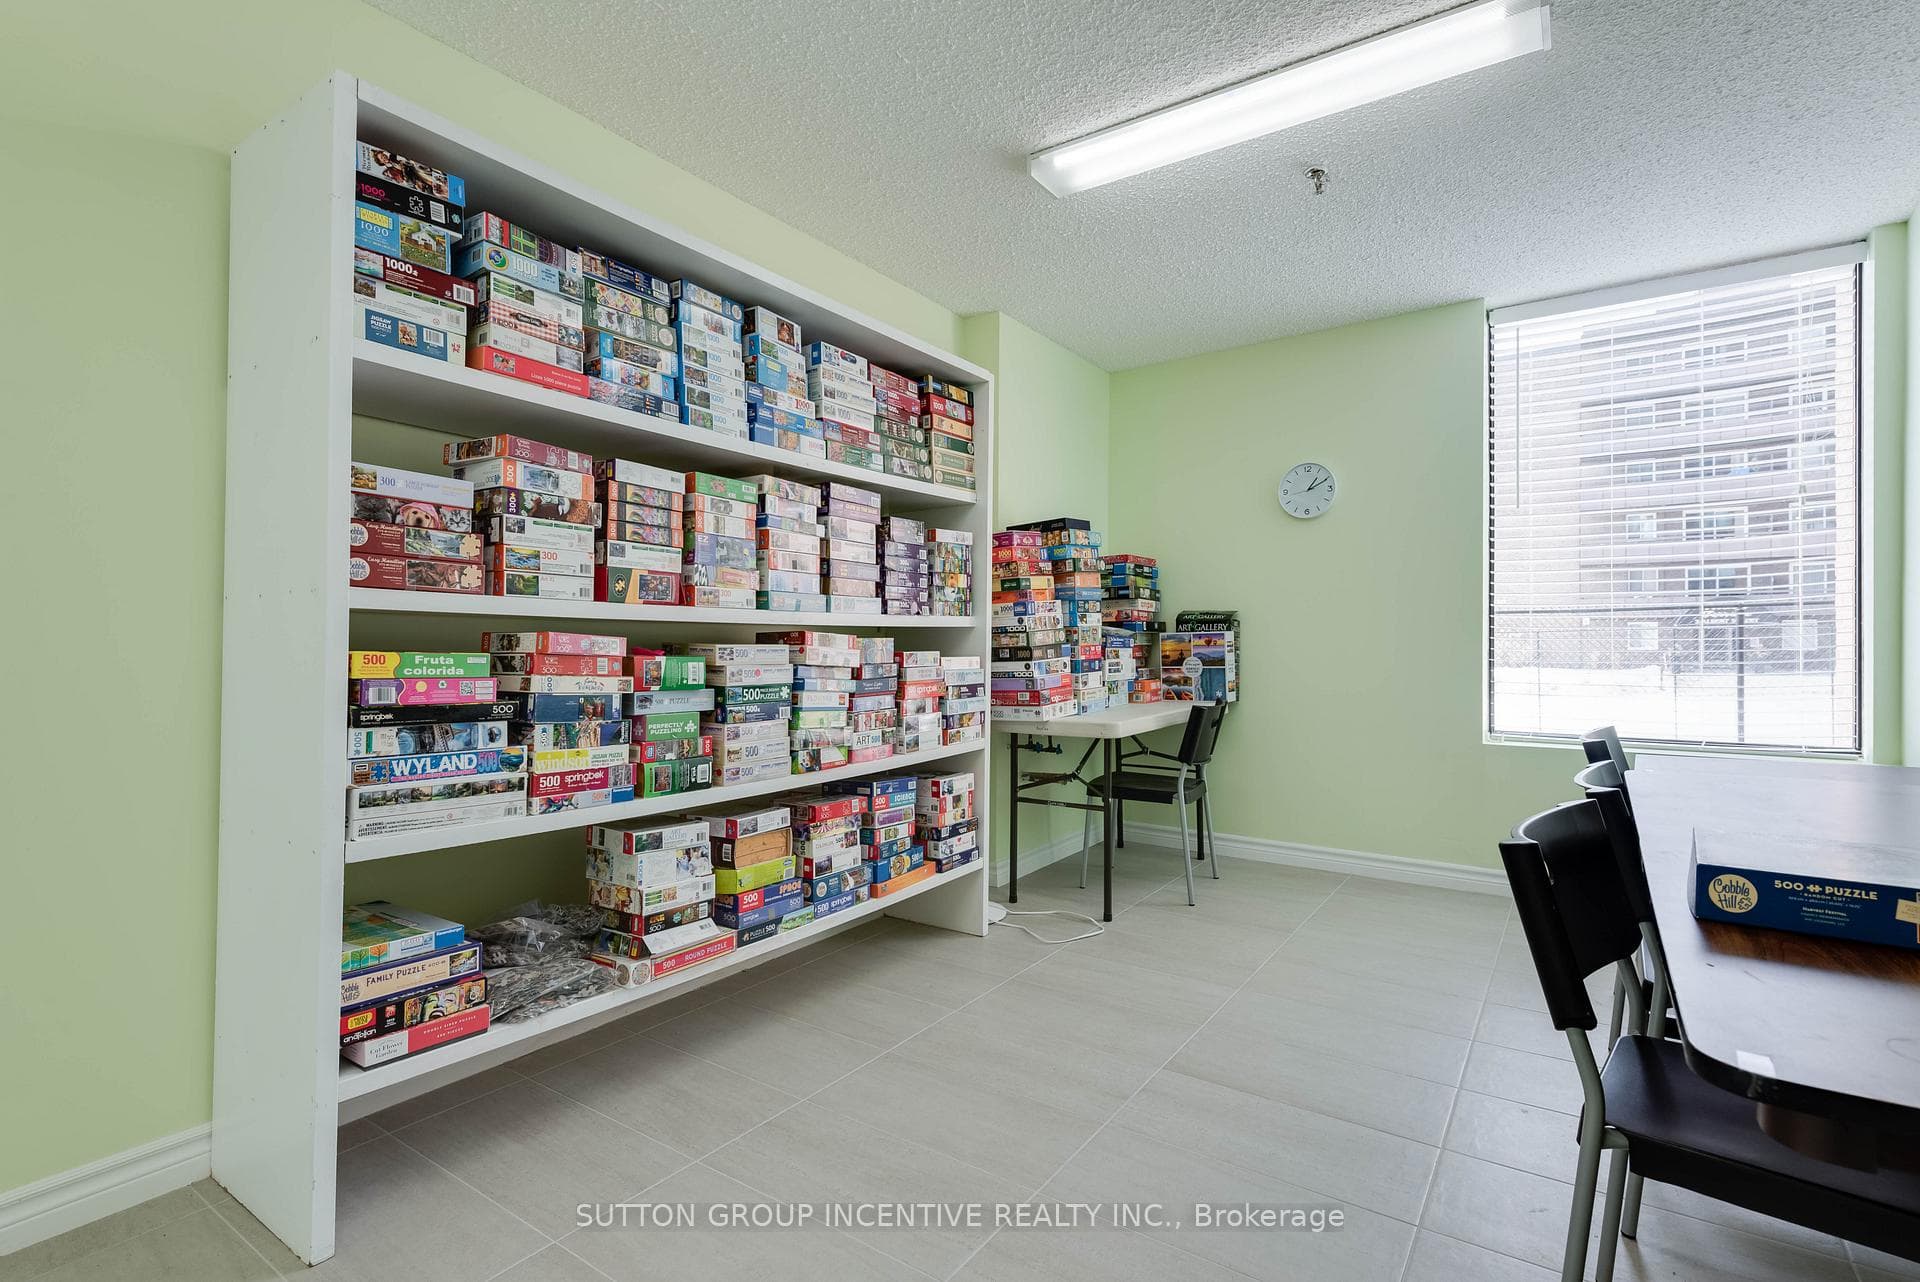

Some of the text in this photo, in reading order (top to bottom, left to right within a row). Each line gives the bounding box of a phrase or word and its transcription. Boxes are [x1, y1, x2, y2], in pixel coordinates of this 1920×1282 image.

[361, 221, 389, 237] 1000
[1304, 465, 1312, 473] 12
[380, 477, 396, 487] 300
[1282, 488, 1289, 496] 9
[1327, 485, 1333, 493] 3
[1304, 508, 1310, 516] 6
[1178, 623, 1228, 632] ART GALLERY
[363, 654, 454, 665] 500 Fruta
[403, 667, 465, 676] colorida
[743, 688, 761, 701] 500
[492, 705, 514, 714] 500
[648, 721, 685, 730] PERFECTLY
[650, 725, 682, 735] PUZZLING
[856, 735, 871, 745] ART
[745, 745, 759, 758] 500
[391, 754, 478, 776] WYLAND
[539, 770, 605, 788] 500 springbok
[1713, 878, 1750, 897] Cobble
[1774, 879, 1878, 901] 500 PUZZLE
[743, 892, 758, 904] 500
[1718, 893, 1737, 909] Hill
[817, 902, 829, 914] 500
[684, 950, 706, 961] ROUND
[706, 941, 728, 956] PUZZLE
[366, 973, 393, 987] FAMILY
[396, 964, 426, 980] PUZZLE
